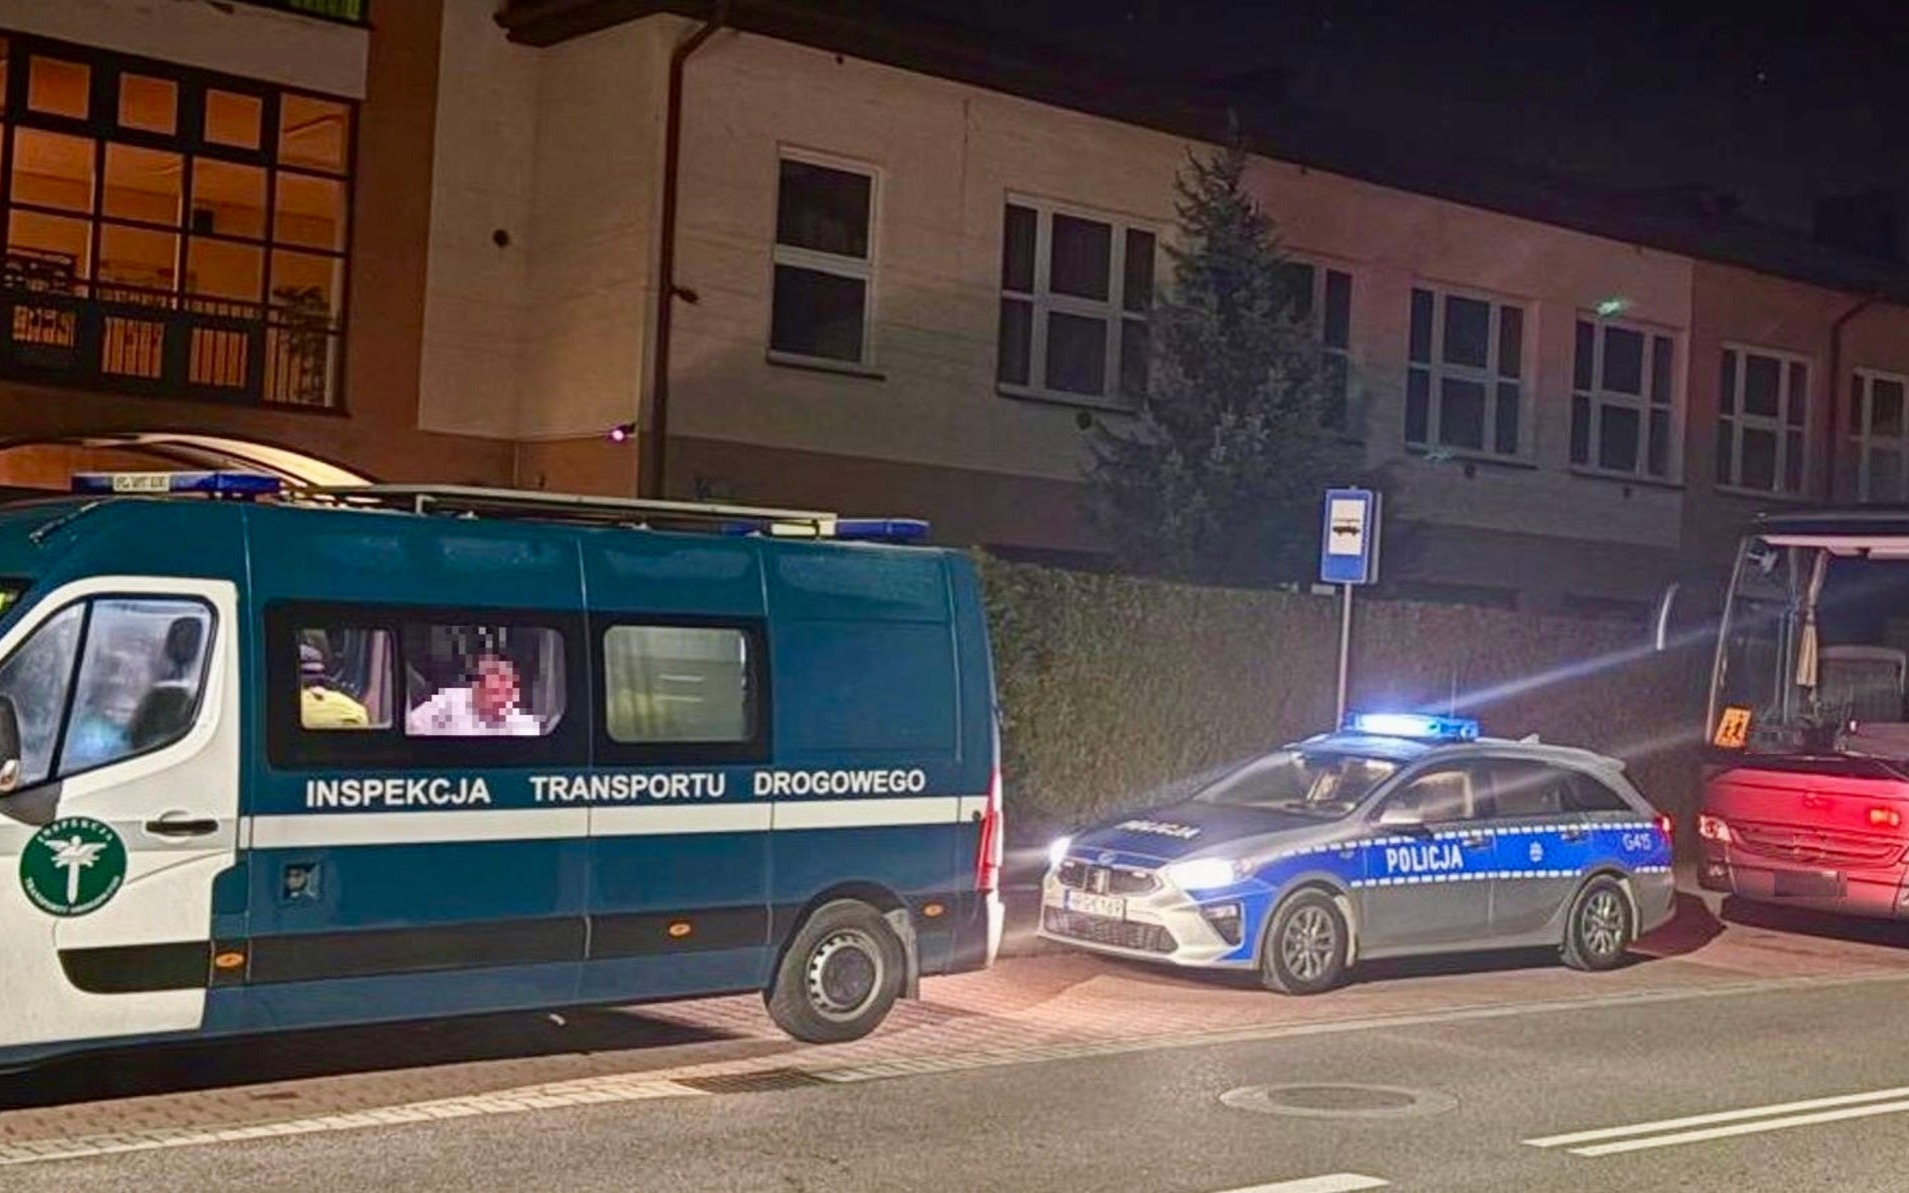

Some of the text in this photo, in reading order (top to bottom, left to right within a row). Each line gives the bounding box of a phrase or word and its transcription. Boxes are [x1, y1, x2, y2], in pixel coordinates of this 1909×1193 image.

[306, 769, 926, 807] INSPEKCJA TRANSPORTU DROGOWEGO
[1622, 832, 1652, 852] G415
[1385, 844, 1464, 874] POLICJA
